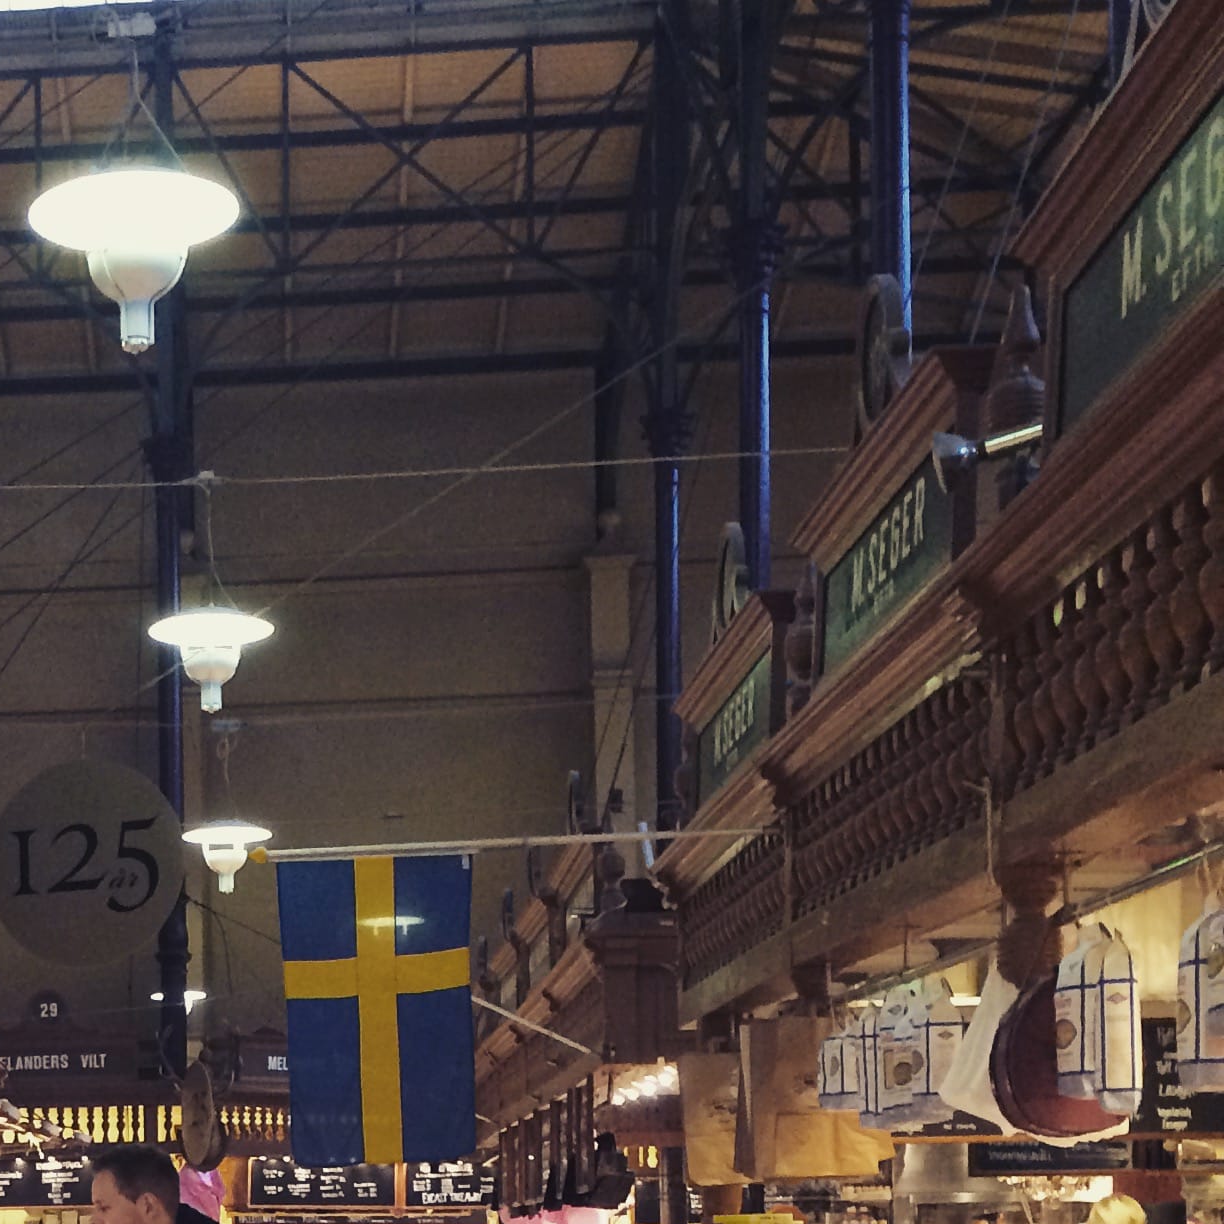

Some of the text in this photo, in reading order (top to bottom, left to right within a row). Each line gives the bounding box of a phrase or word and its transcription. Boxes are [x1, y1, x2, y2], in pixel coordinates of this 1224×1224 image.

[10, 815, 160, 913] 125
[40, 1002, 58, 1018] 29
[80, 1053, 107, 1069] VILT
[268, 1055, 288, 1071] MEL
